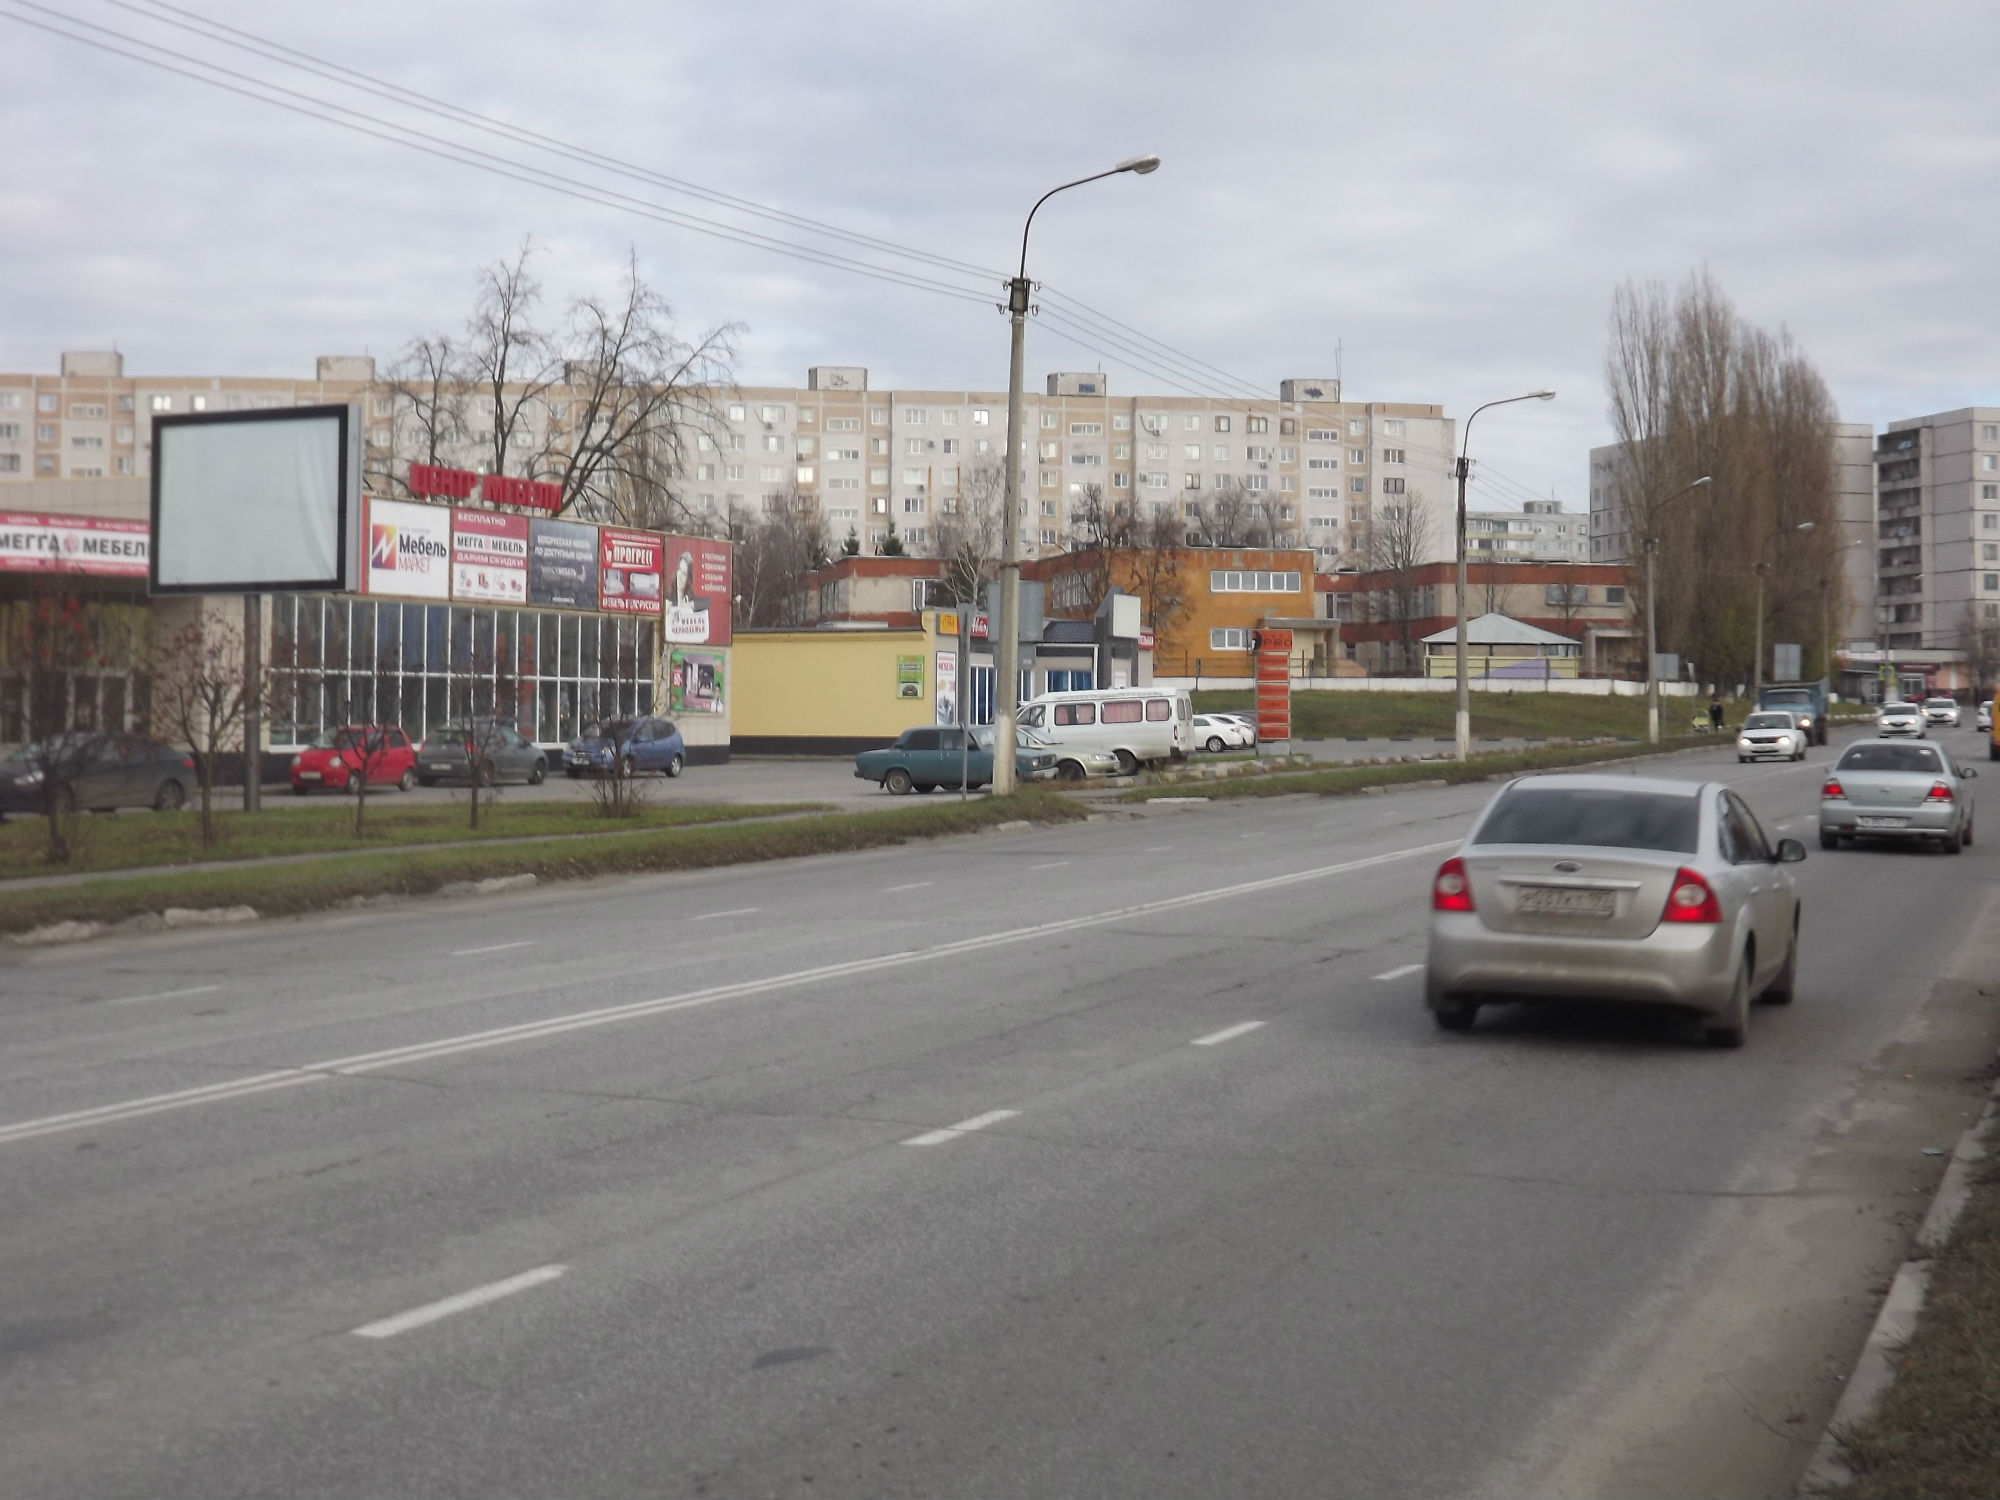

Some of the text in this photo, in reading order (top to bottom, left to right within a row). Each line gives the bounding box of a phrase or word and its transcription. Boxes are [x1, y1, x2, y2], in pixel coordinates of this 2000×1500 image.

[410, 462, 563, 511] ЦЕНТР МЕБЕЛИ
[457, 512, 506, 526] БЕСПЛАТНО
[83, 537, 150, 557] МЕБЕЛ
[400, 534, 447, 557] Мебель
[457, 535, 524, 554] МЕГГА МЕБЕЛЬ
[489, 556, 524, 568] СКИДКИ
[613, 545, 653, 565] ПРОГРЕСС
